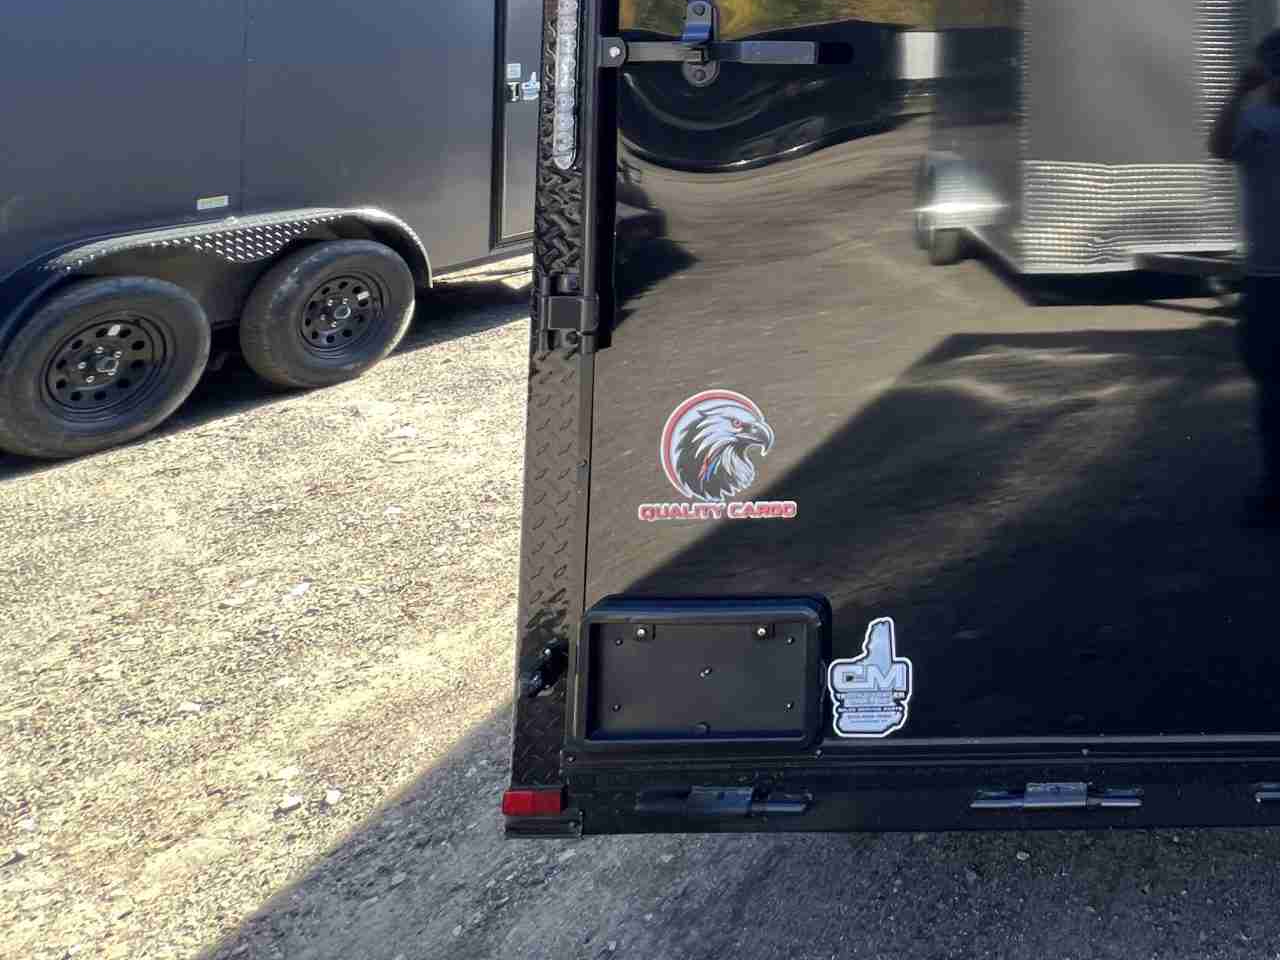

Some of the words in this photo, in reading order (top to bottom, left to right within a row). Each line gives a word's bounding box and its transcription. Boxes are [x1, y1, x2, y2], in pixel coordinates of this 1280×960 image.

[639, 503, 724, 521] QUALITY
[727, 502, 797, 518] CARGO
[833, 663, 907, 692] CM
